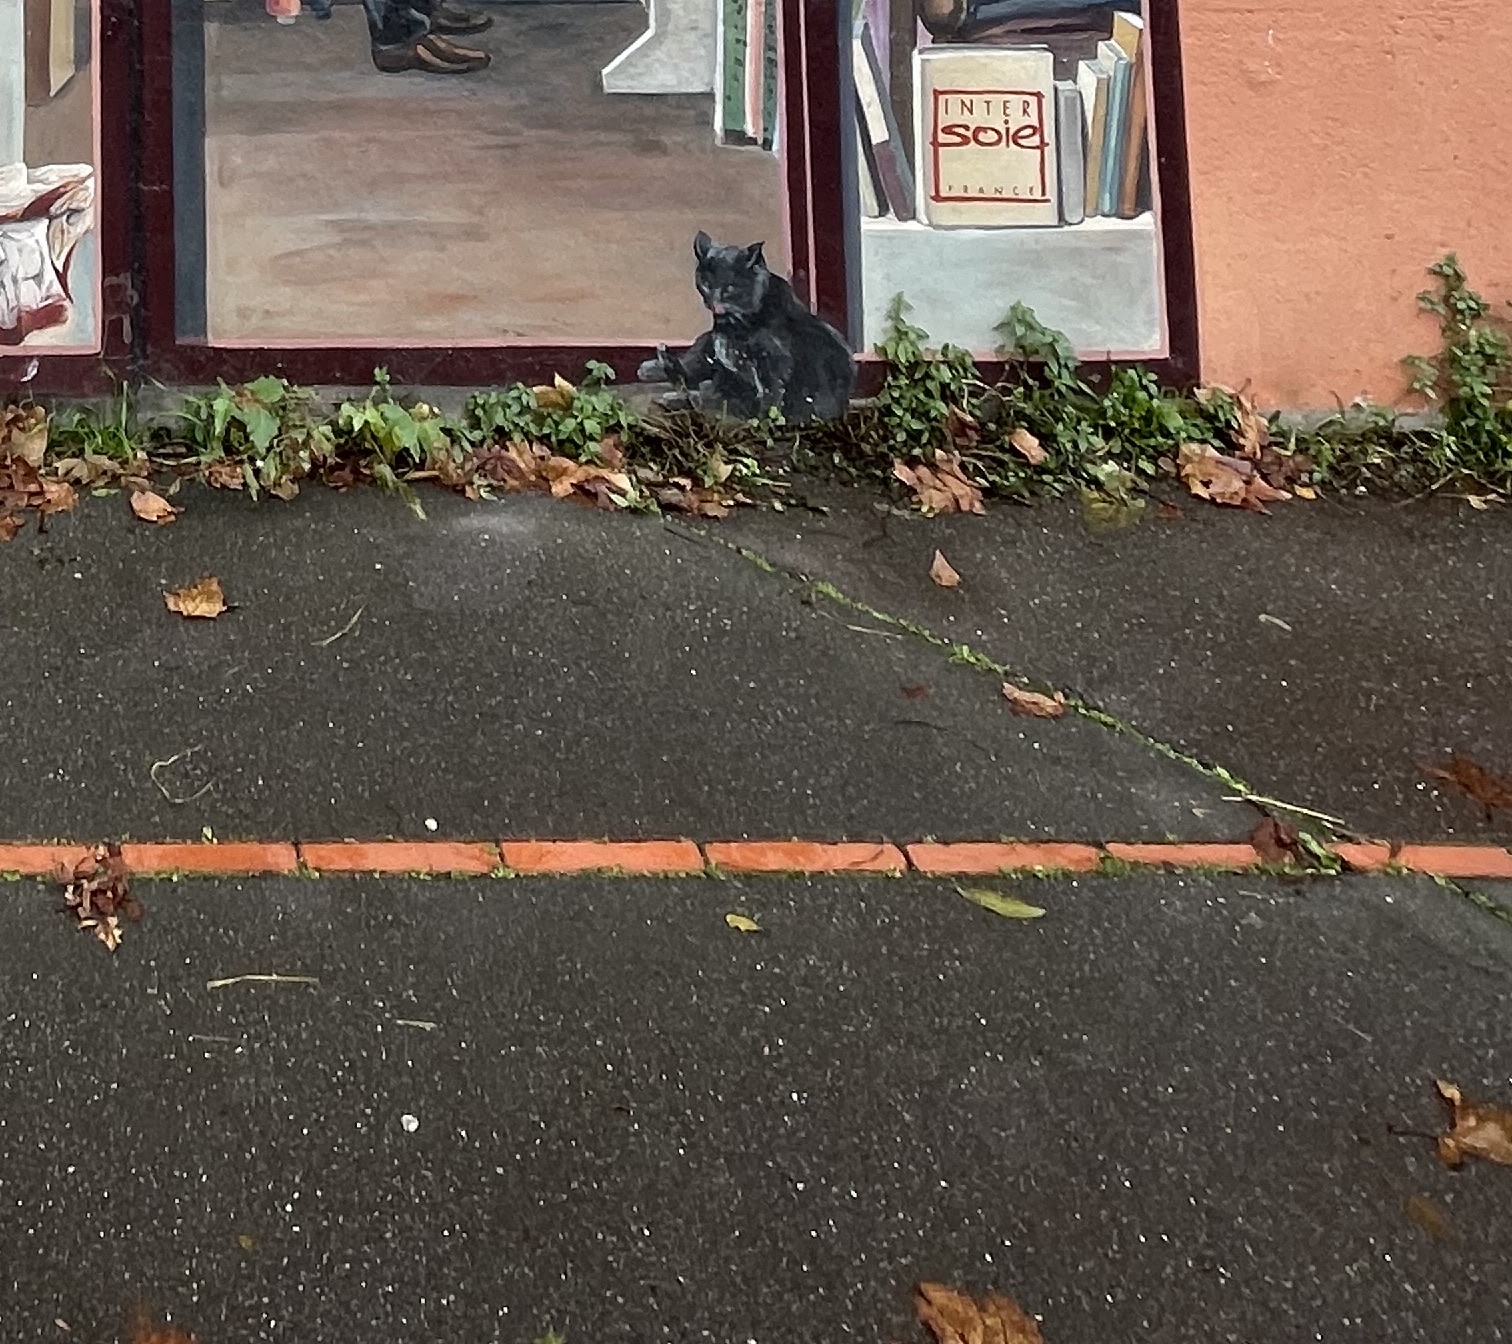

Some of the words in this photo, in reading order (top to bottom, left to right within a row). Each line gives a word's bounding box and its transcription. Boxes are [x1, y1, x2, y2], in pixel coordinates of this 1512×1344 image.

[944, 98, 1031, 117] INTER
[932, 119, 1049, 149] soie
[948, 185, 1034, 196] FRANCE
